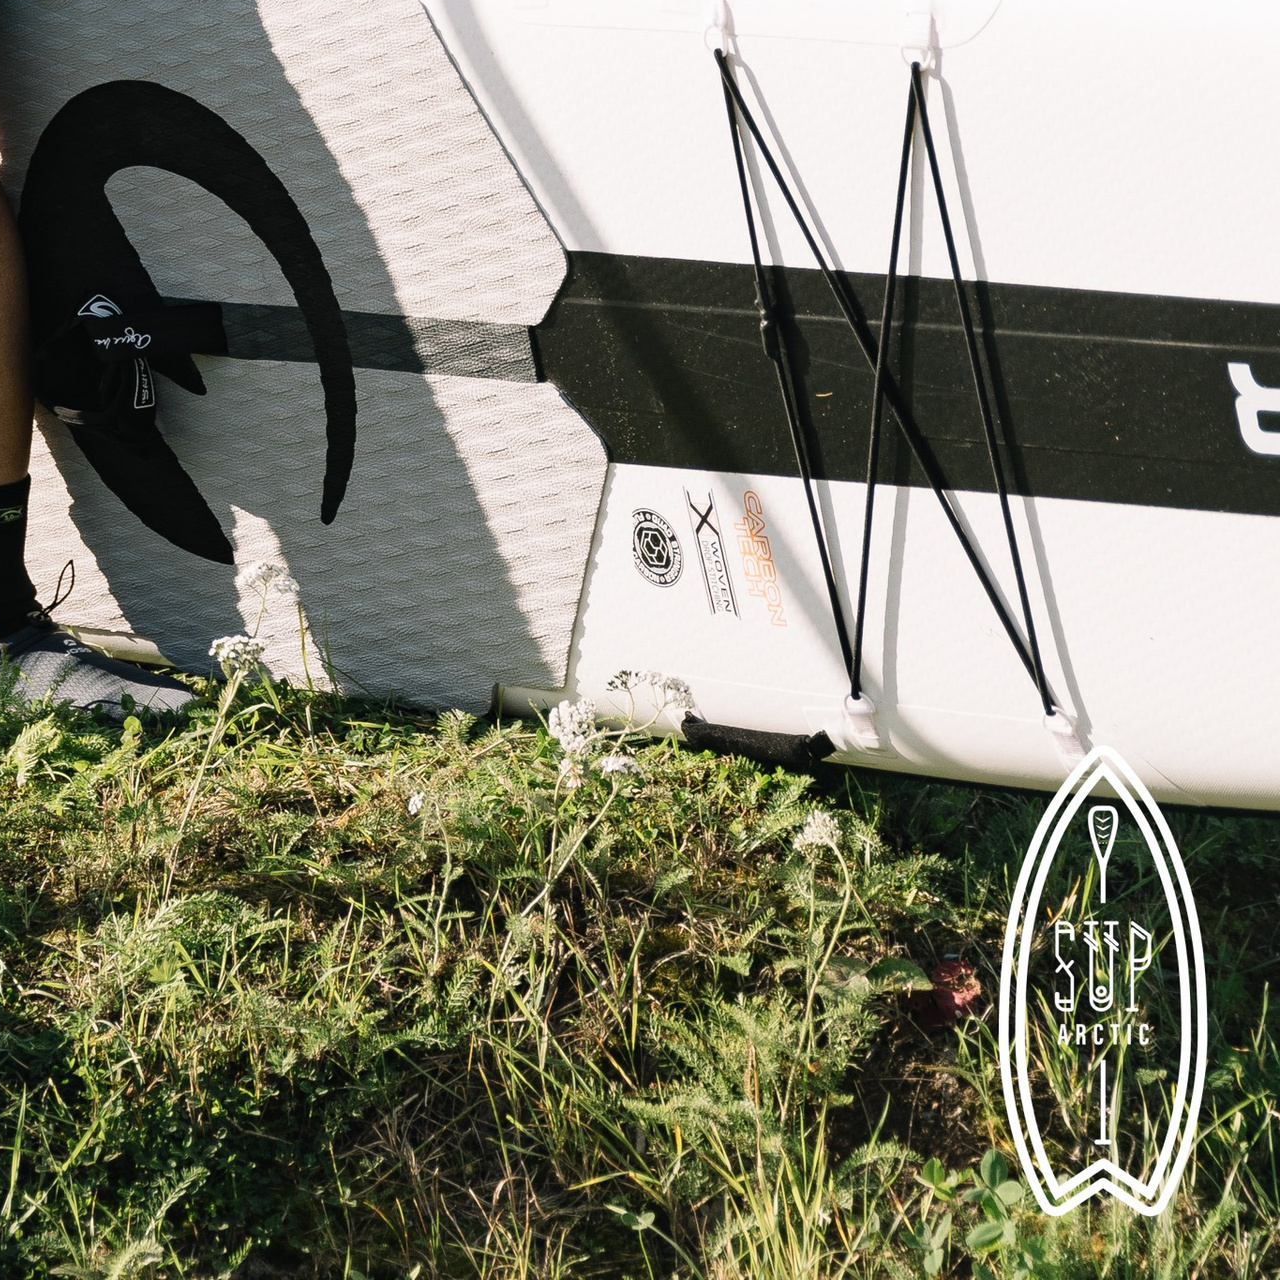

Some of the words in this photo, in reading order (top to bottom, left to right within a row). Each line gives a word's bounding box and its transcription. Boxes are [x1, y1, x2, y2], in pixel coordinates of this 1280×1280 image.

[701, 540, 713, 566] DROP
[708, 566, 724, 613] STITCHING
[710, 541, 732, 613] WOVEN
[733, 516, 766, 598] TECH
[743, 489, 788, 627] CARBON
